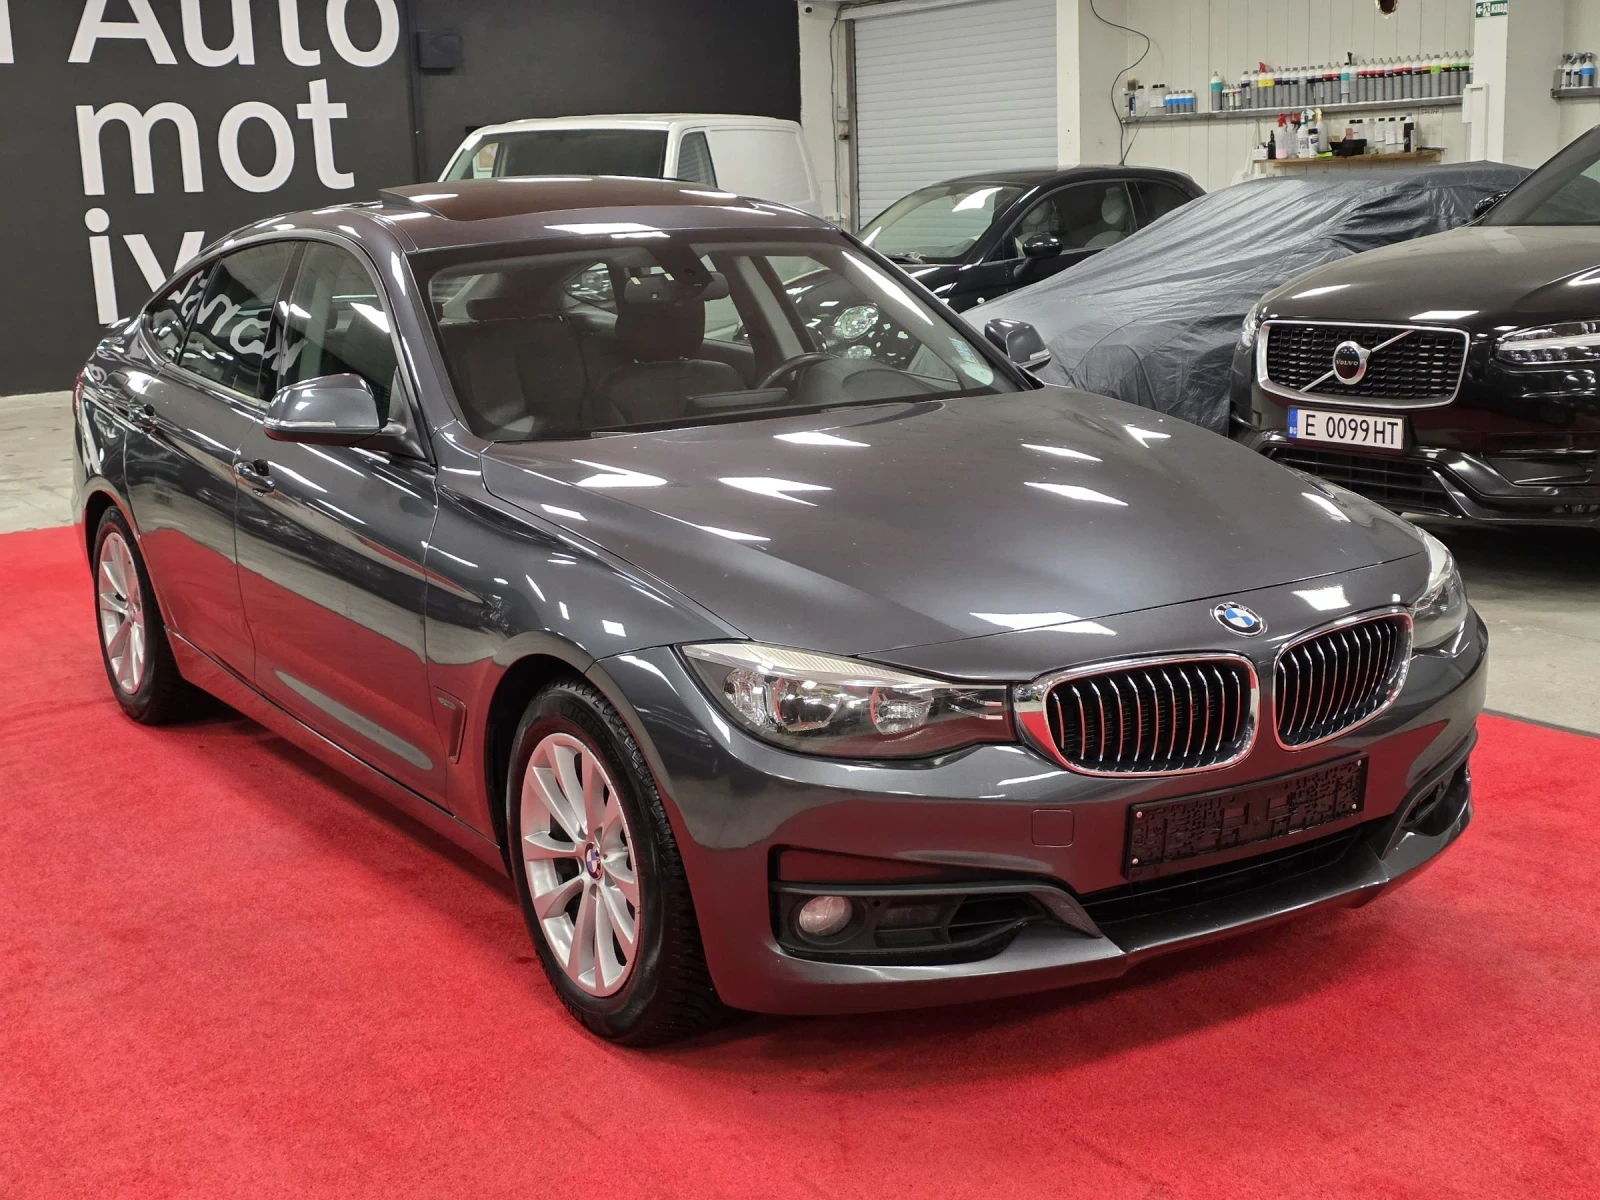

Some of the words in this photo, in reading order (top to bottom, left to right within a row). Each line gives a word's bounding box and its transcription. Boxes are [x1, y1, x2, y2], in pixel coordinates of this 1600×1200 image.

[76, 78, 355, 196] mot
[84, 207, 205, 325] iv
[1305, 413, 1317, 437] E
